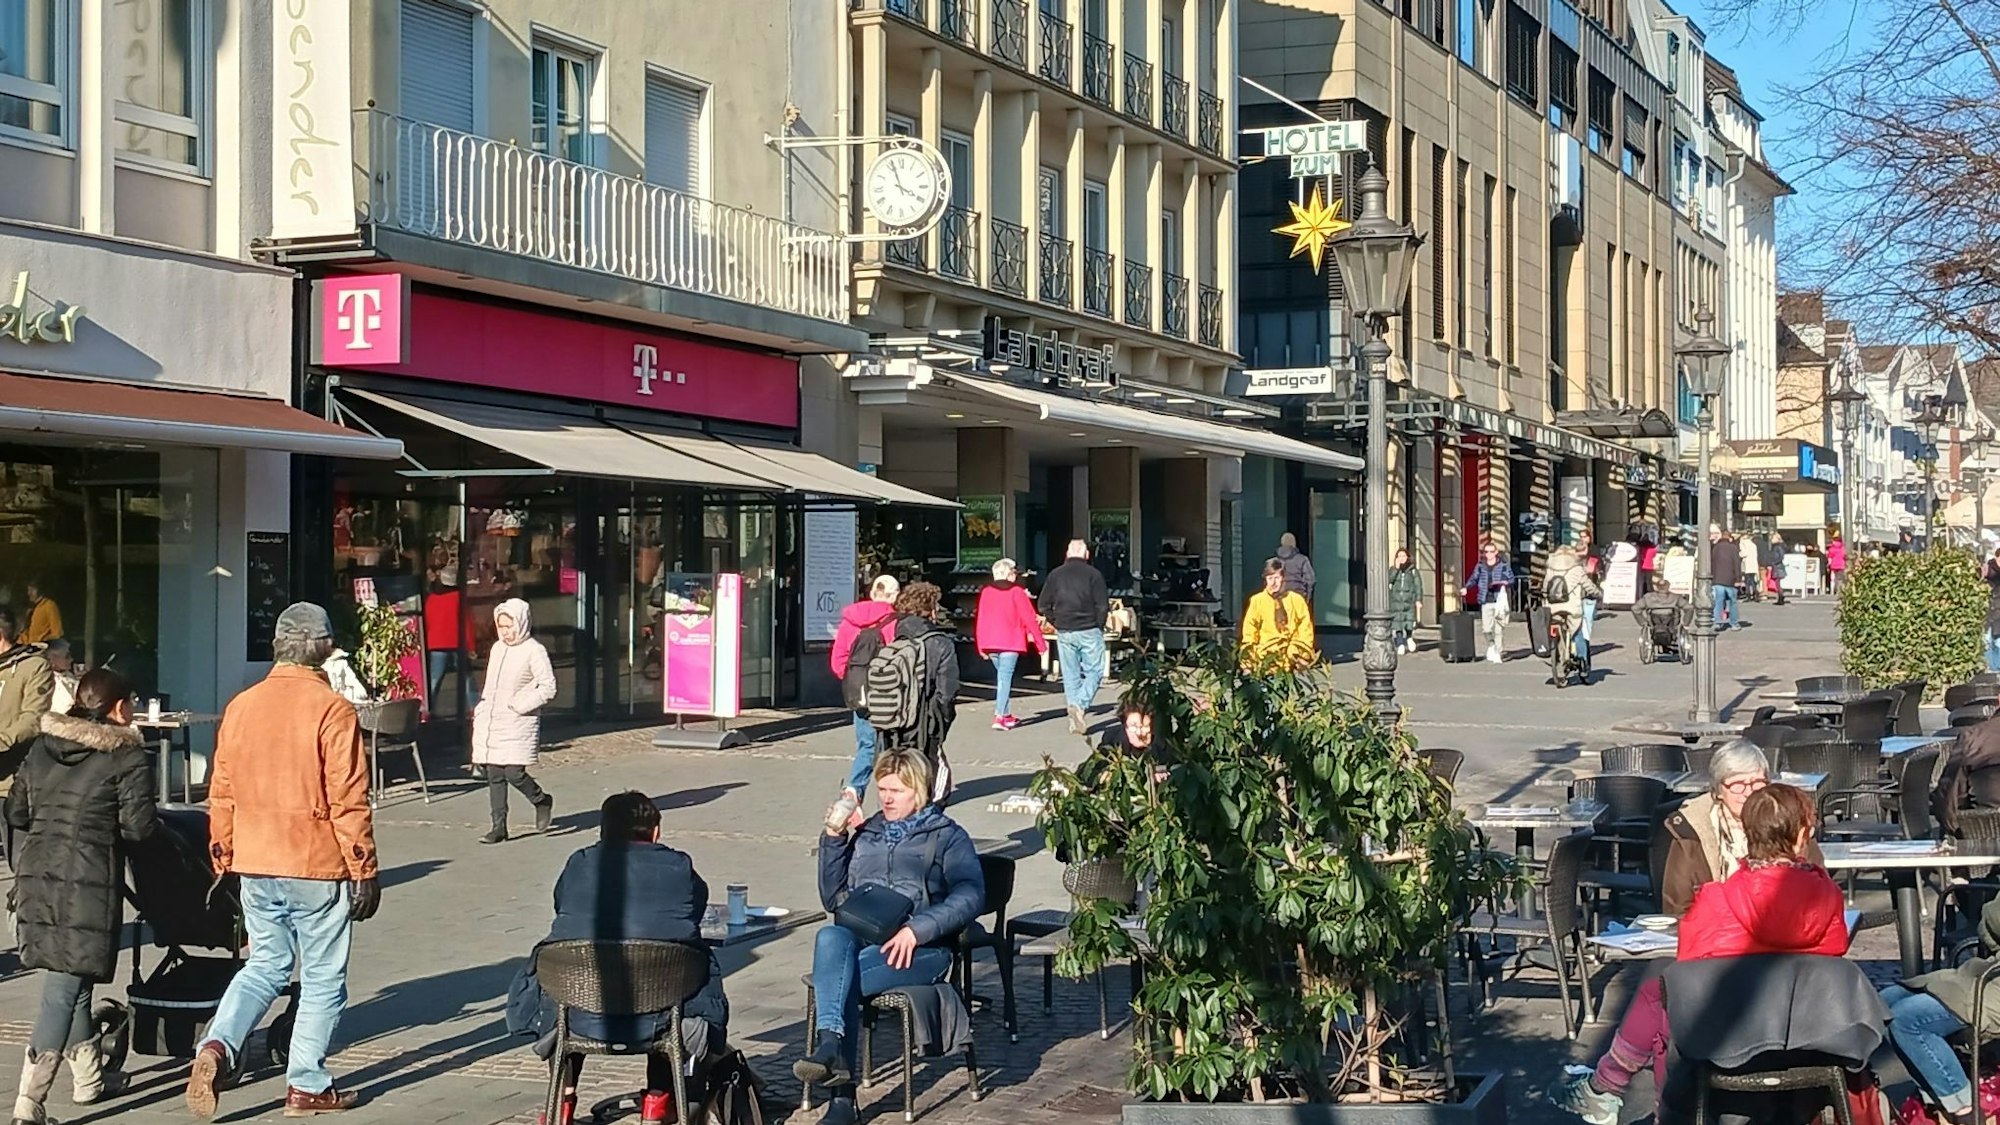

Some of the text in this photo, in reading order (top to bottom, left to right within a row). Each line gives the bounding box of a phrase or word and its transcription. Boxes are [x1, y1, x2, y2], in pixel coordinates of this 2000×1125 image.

[1267, 124, 1359, 154] HOTEL
[1292, 154, 1335, 175] ZUM
[338, 289, 381, 350] T
[993, 316, 1113, 389] Landgraf
[1250, 373, 1327, 389] Landgraf
